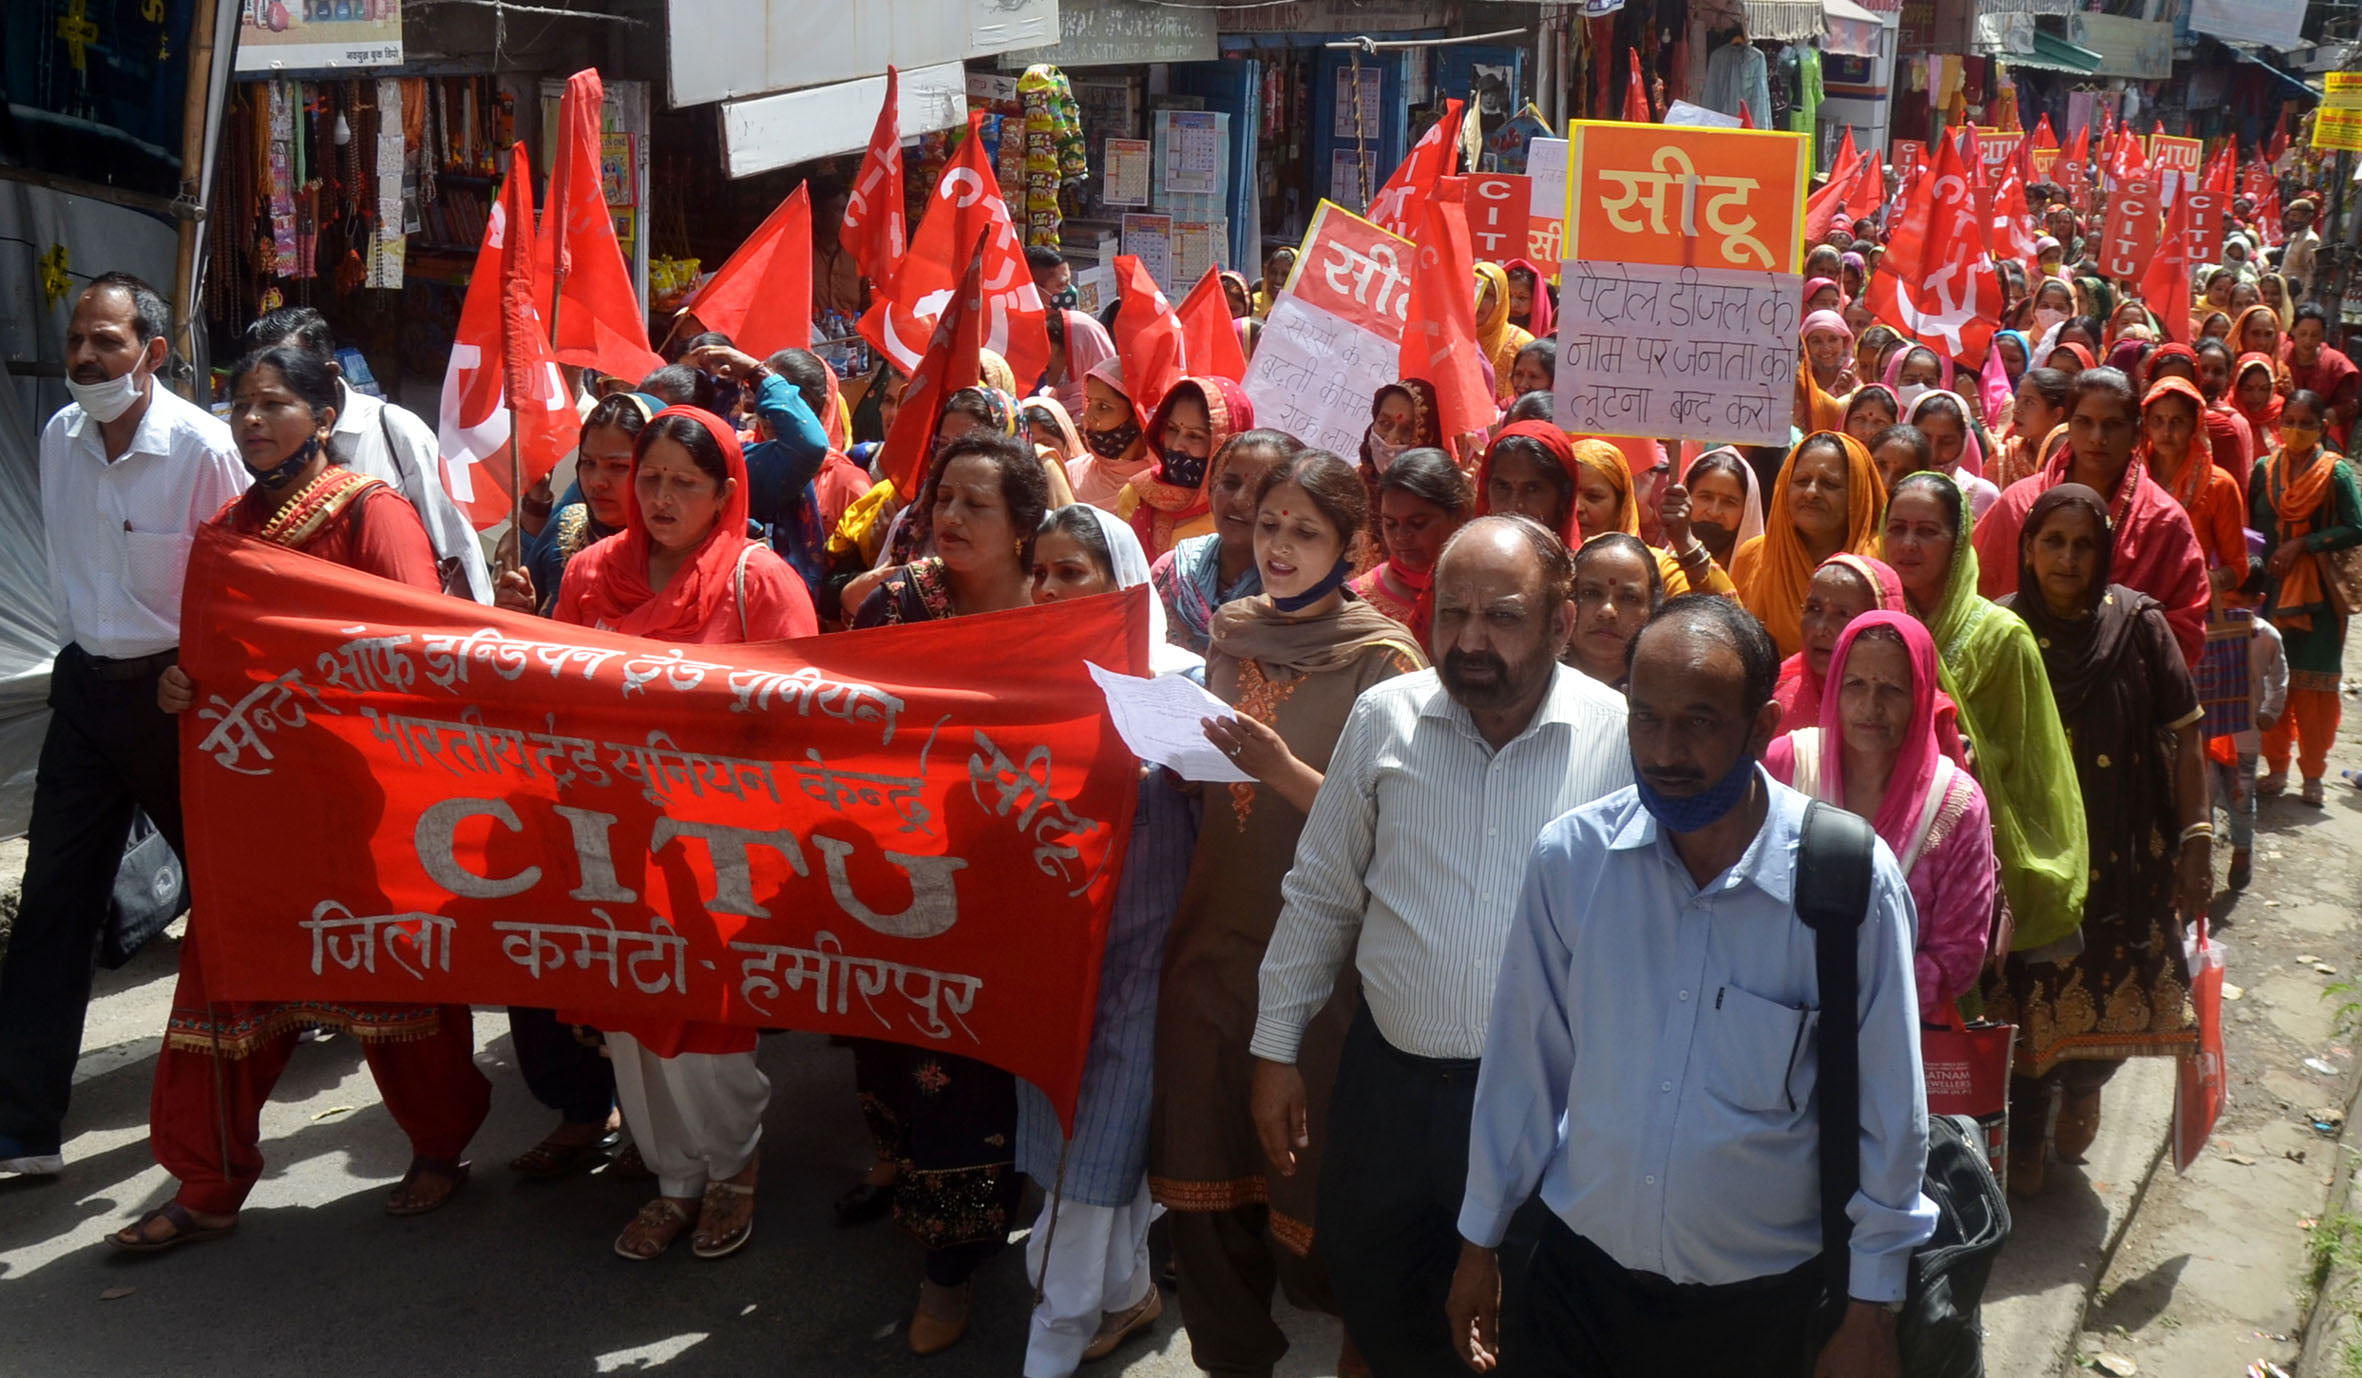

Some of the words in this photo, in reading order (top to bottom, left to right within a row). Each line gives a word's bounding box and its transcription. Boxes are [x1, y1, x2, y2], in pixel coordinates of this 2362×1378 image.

[1475, 180, 1511, 267] CIT
[1599, 146, 1776, 269] सीटू
[2112, 200, 2144, 276] CITU
[2188, 195, 2211, 260] CITU
[1758, 272, 1794, 335] के
[1567, 334, 1628, 374] नाम
[1636, 337, 1672, 379] पर
[1673, 340, 1758, 381] जनता
[1760, 336, 1794, 383] को
[1570, 384, 1654, 430] लूटना
[1670, 390, 1716, 427] बन्द
[1726, 382, 1778, 433] करो
[360, 703, 537, 779] भारतीय
[603, 729, 782, 807] यूनियन
[414, 796, 968, 939] CITU
[299, 900, 457, 980] जिला
[492, 908, 688, 995] कमेटी
[729, 930, 983, 1044] हमीरपुर
